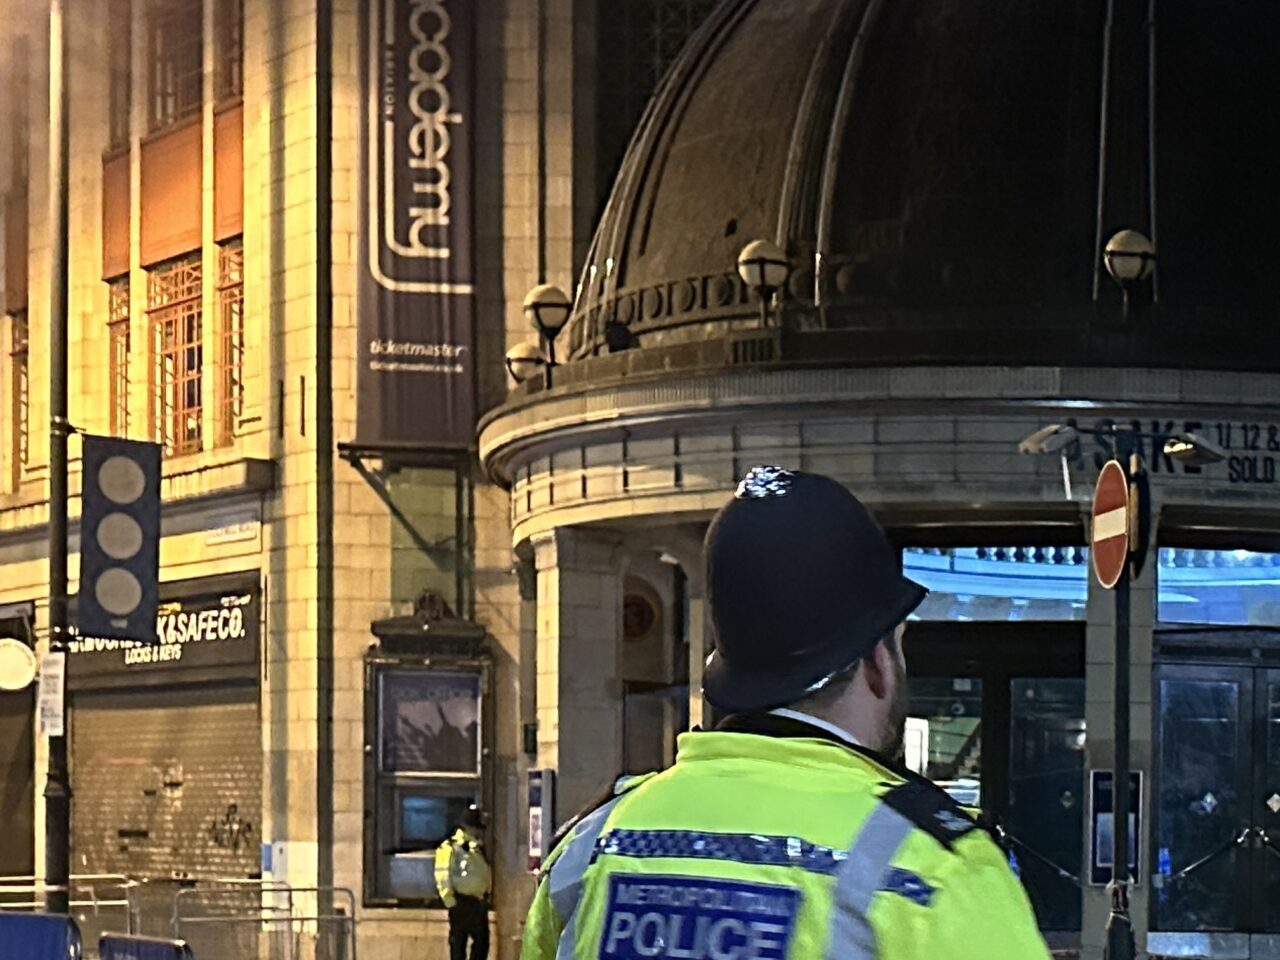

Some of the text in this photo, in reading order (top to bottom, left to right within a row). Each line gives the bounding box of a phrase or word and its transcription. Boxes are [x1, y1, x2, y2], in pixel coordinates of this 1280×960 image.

[398, 0, 463, 258] cademy
[369, 339, 466, 357] ticketmaster
[1241, 423, 1260, 450] 12
[1267, 425, 1280, 452] &
[1228, 455, 1276, 483] SOLD
[125, 646, 152, 664] LOCKS
[159, 643, 182, 661] KEYS
[616, 882, 791, 916] METROPOLITAN
